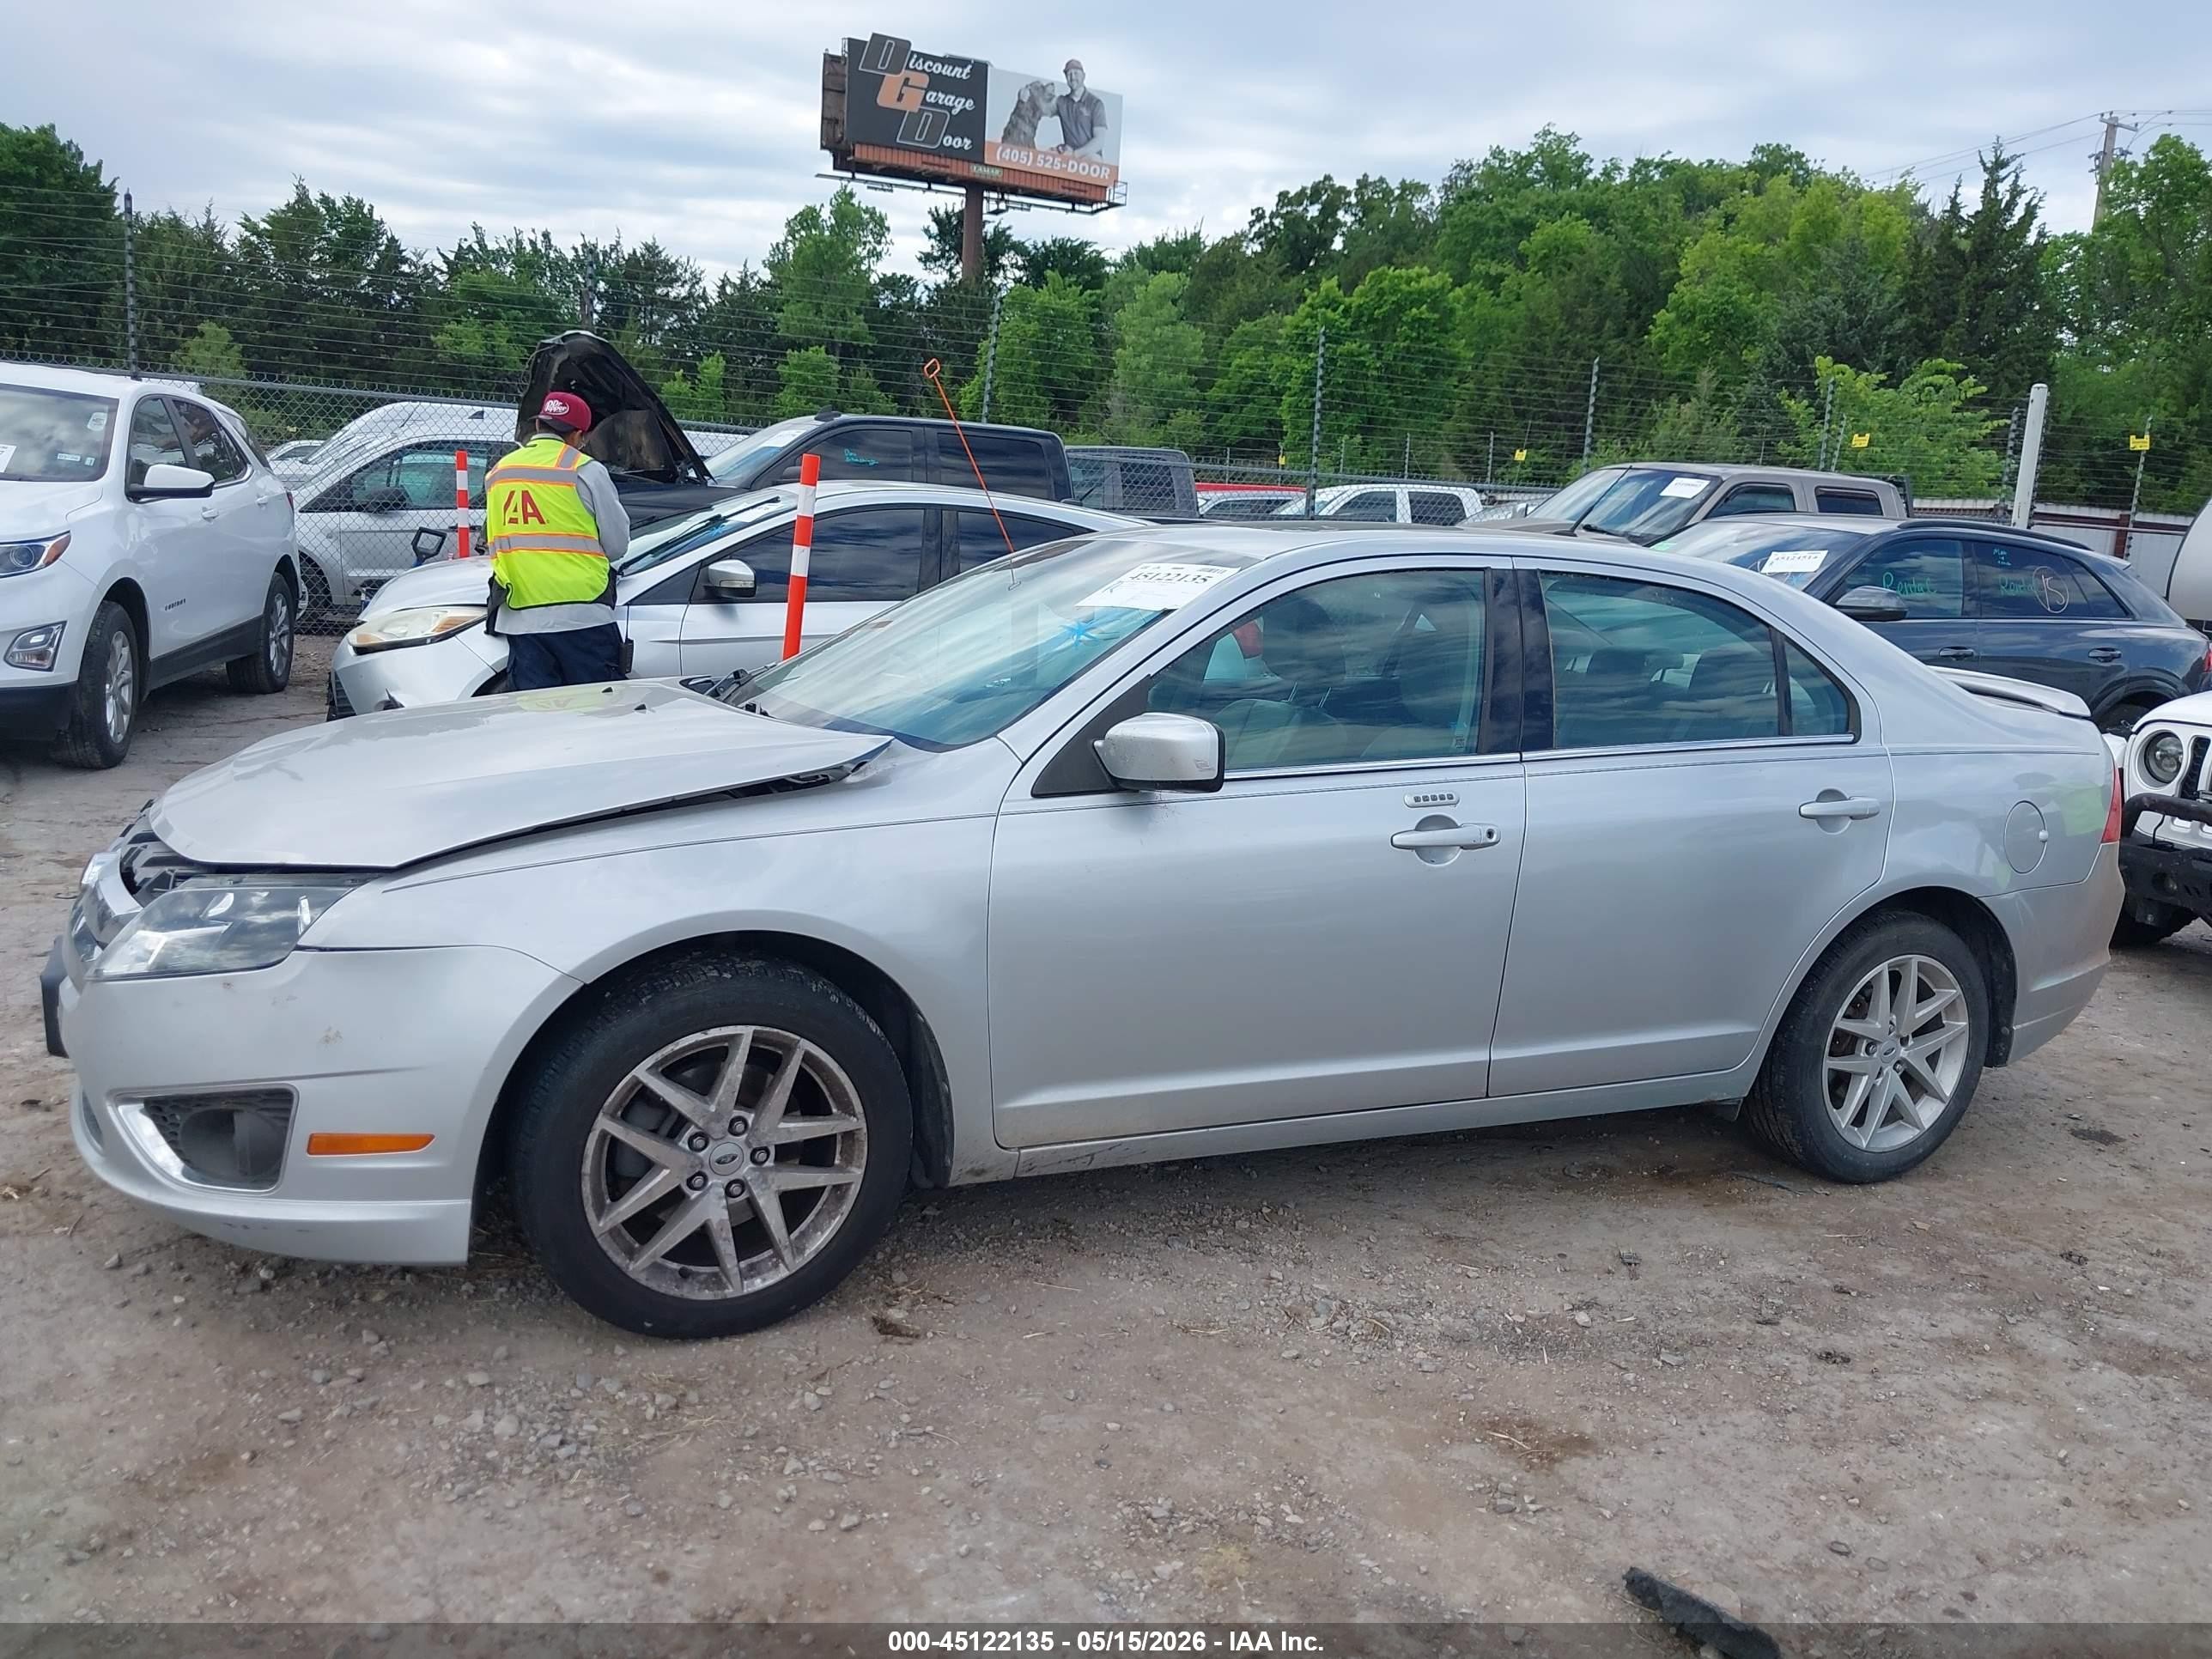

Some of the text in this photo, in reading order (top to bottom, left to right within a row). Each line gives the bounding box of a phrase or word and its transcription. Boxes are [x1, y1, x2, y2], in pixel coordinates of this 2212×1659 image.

[859, 33, 972, 80] Discount
[877, 69, 975, 115] Garage
[896, 106, 972, 149] Door
[996, 145, 1111, 180] (405) 525-DOOR
[1129, 571, 1214, 585] 45122135
